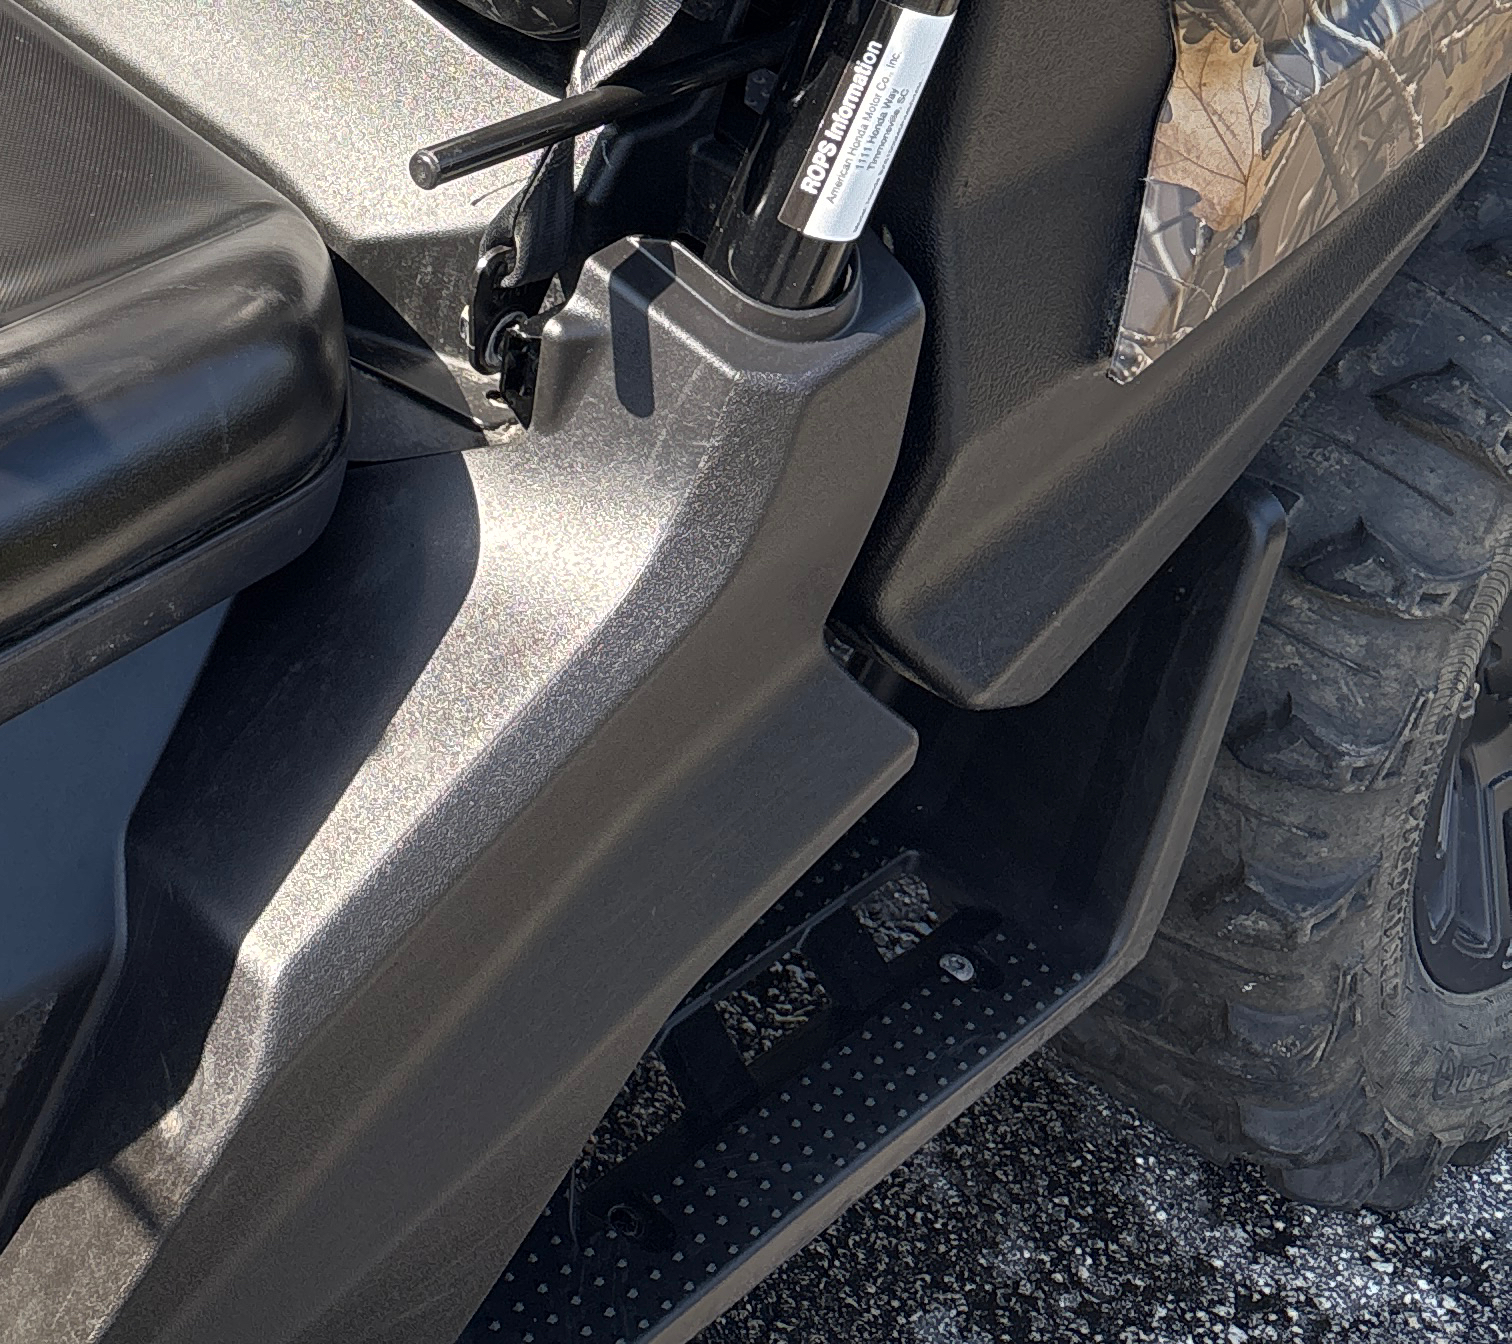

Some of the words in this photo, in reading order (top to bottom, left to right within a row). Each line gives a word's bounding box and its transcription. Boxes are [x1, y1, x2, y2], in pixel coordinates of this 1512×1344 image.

[800, 140, 837, 195] ROPS
[824, 40, 883, 142] Information
[826, 156, 853, 205] American
[847, 124, 868, 158] Honda
[862, 92, 882, 123] Motor
[885, 51, 902, 69] Inc.
[855, 147, 873, 169] 1111
[867, 113, 887, 145] Honda
[881, 88, 899, 112] Way
[897, 88, 910, 104] SC
